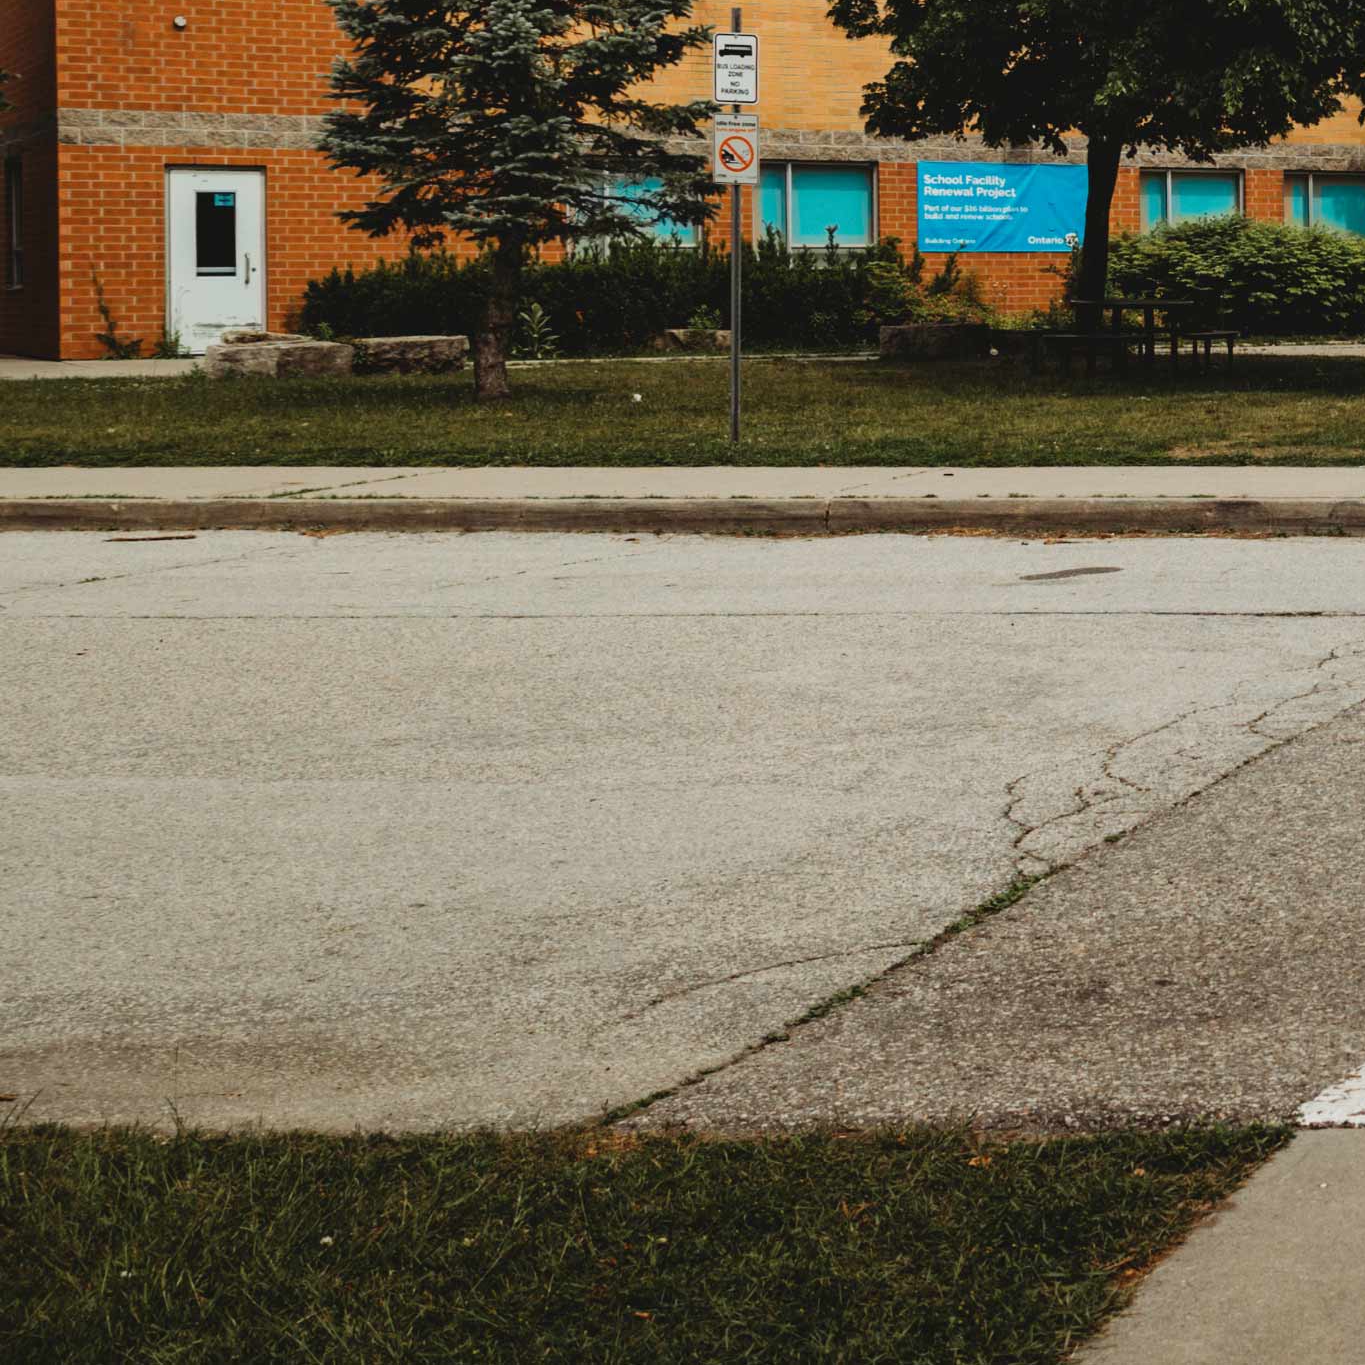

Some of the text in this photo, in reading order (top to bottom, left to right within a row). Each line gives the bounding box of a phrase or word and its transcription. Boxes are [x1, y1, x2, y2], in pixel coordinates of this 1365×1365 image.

[923, 174, 1006, 188] School Facility
[923, 186, 1017, 199] Renewal Project
[923, 204, 940, 212] Part
[941, 204, 949, 212] of
[979, 205, 1002, 213] billion
[924, 237, 952, 245] Building
[1027, 235, 1064, 245] Ontario
